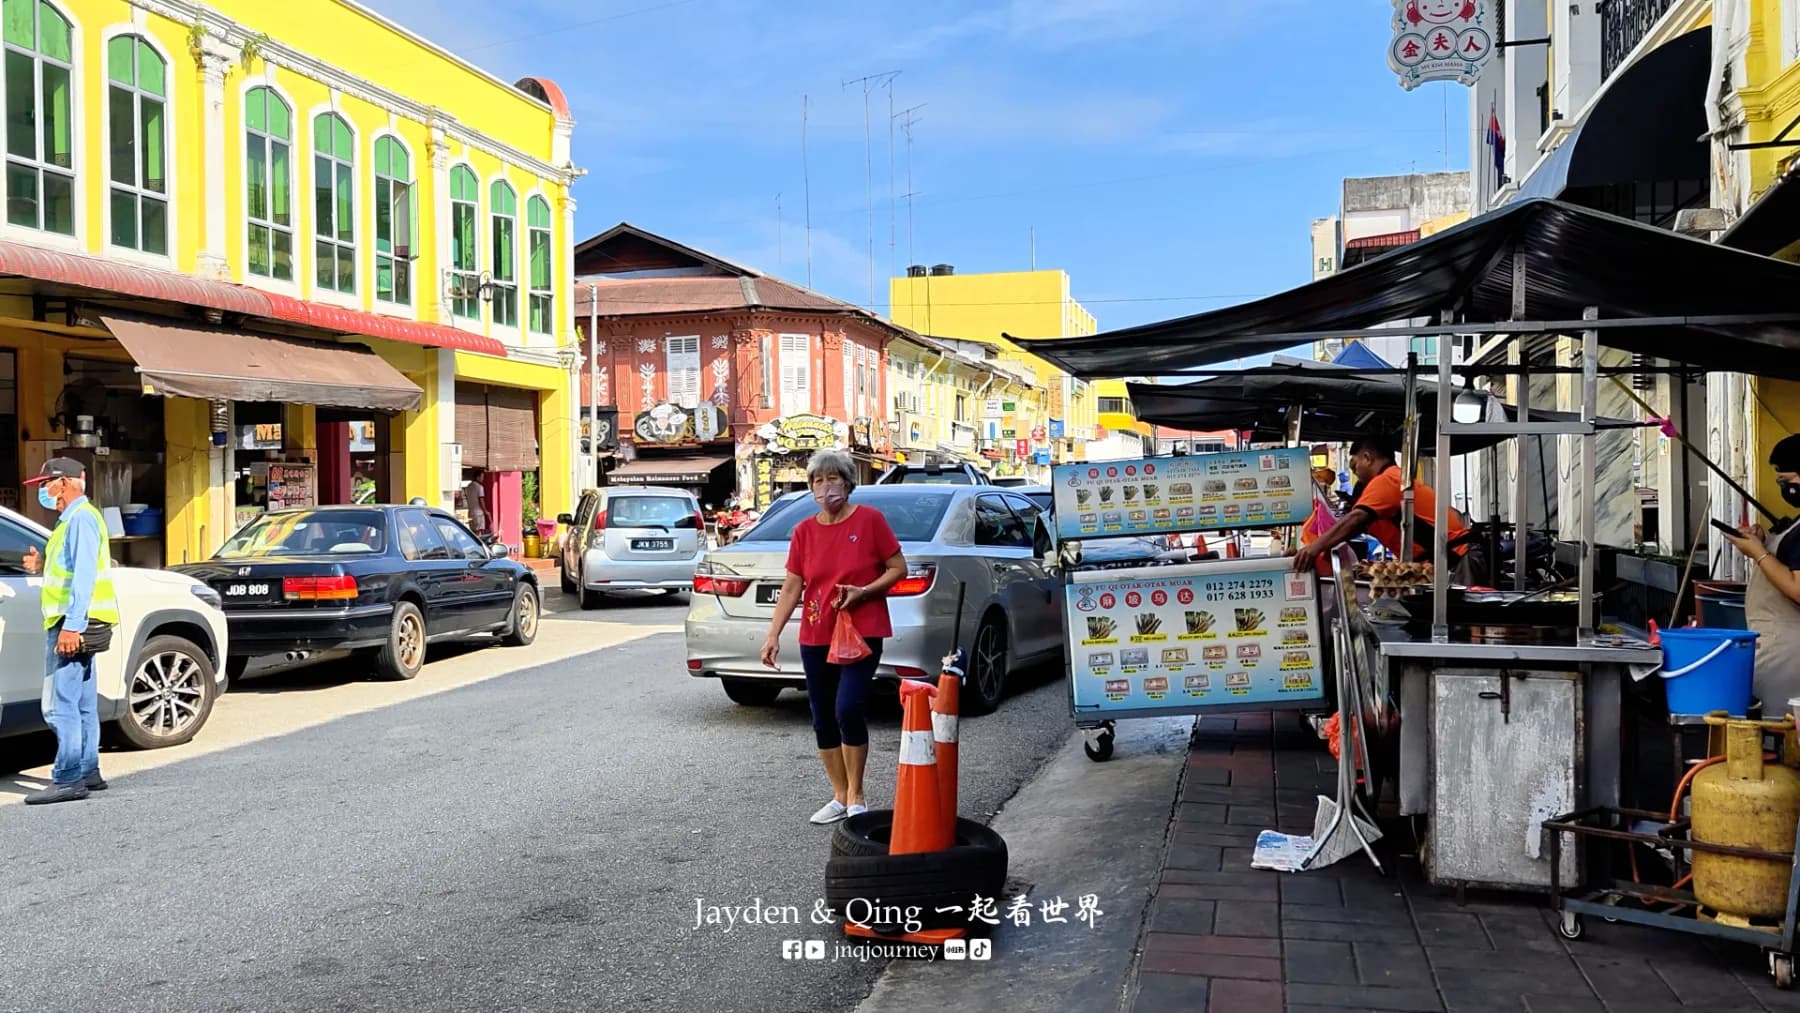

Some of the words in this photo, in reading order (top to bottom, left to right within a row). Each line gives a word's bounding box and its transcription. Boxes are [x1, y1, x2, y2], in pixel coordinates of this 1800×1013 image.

[1402, 33, 1482, 58] 金夫人
[248, 584, 269, 595] 808
[1120, 581, 1166, 590] OTAK-OTAK
[1206, 582, 1224, 591] 012
[1228, 581, 1245, 589] 274
[1249, 579, 1273, 588] 2279
[1101, 590, 1192, 607] 麻坡乌达
[1206, 592, 1224, 602] 017
[1228, 591, 1246, 600] 628
[1250, 590, 1274, 599] 1933
